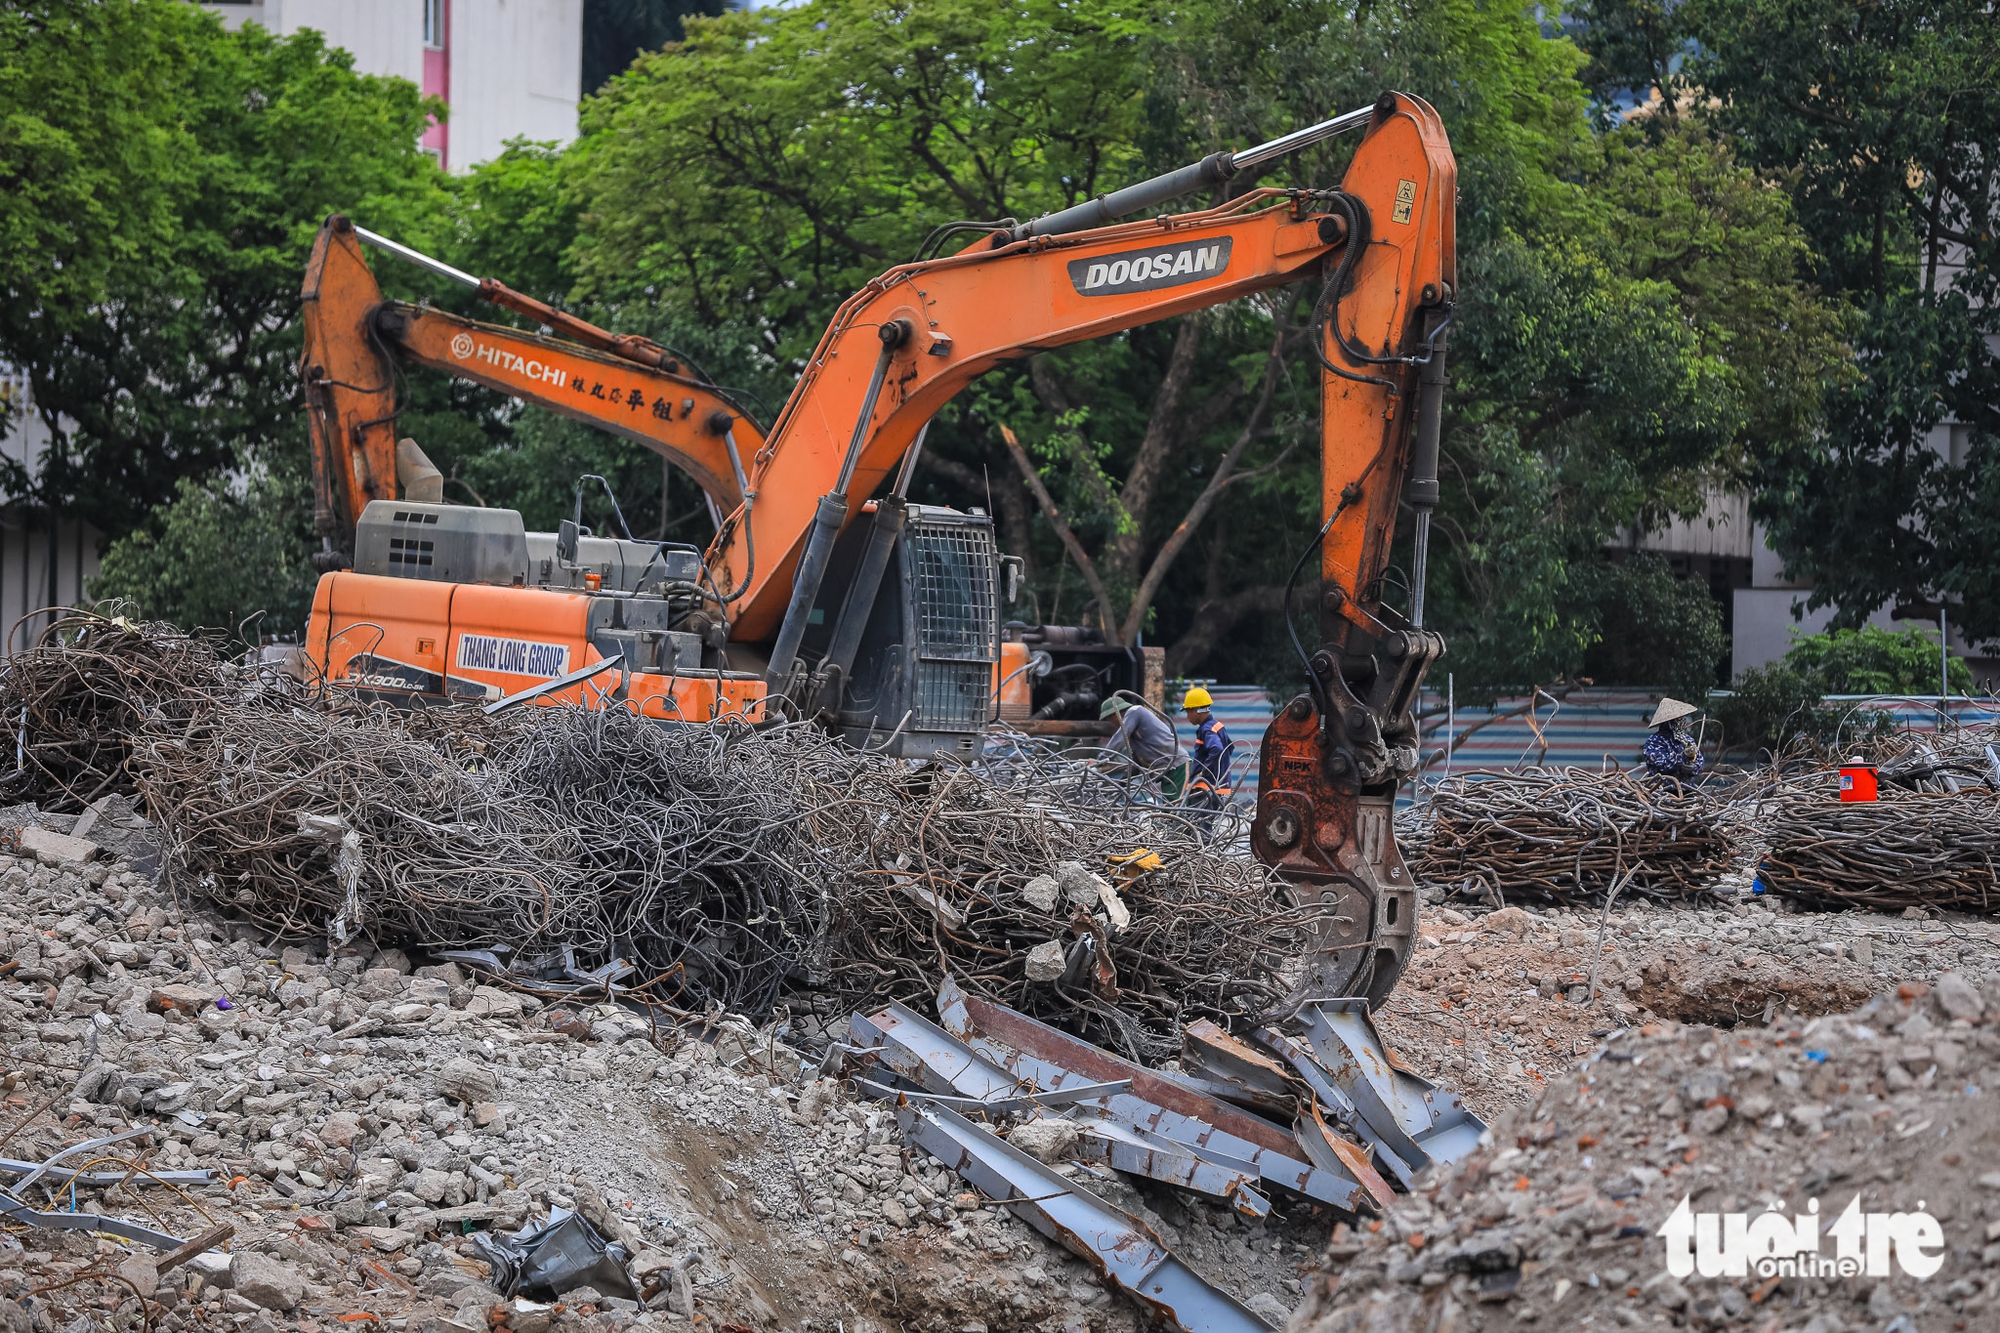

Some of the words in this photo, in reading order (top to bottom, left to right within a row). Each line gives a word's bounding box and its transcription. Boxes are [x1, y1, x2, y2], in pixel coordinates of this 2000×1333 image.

[1085, 245, 1220, 289] DOOSAN
[476, 343, 567, 387] HITACHI
[463, 636, 497, 669] THANG
[498, 640, 527, 673] LONG
[528, 643, 564, 677] GROUP
